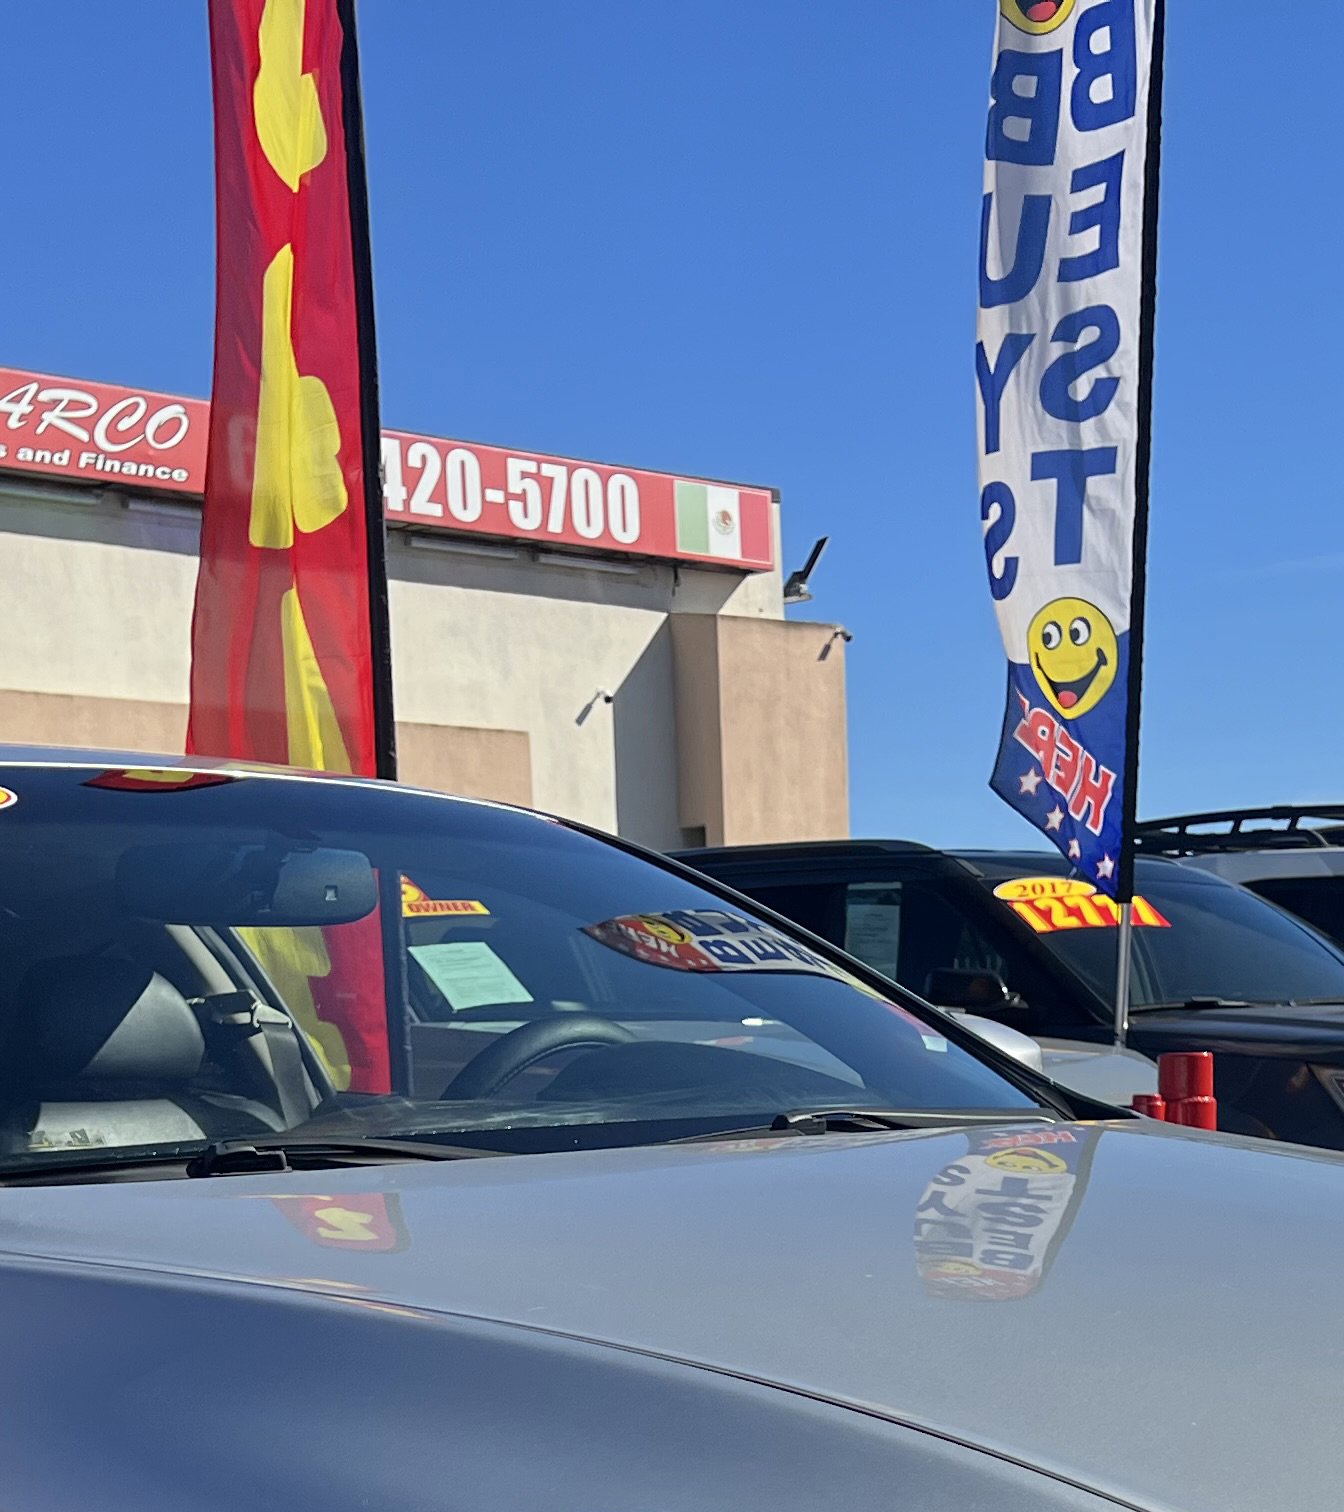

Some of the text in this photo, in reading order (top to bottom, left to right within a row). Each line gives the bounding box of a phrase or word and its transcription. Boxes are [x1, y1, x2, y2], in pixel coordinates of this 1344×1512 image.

[16, 445, 70, 466] and
[78, 452, 189, 482] Finance
[1014, 881, 1074, 898] 2017
